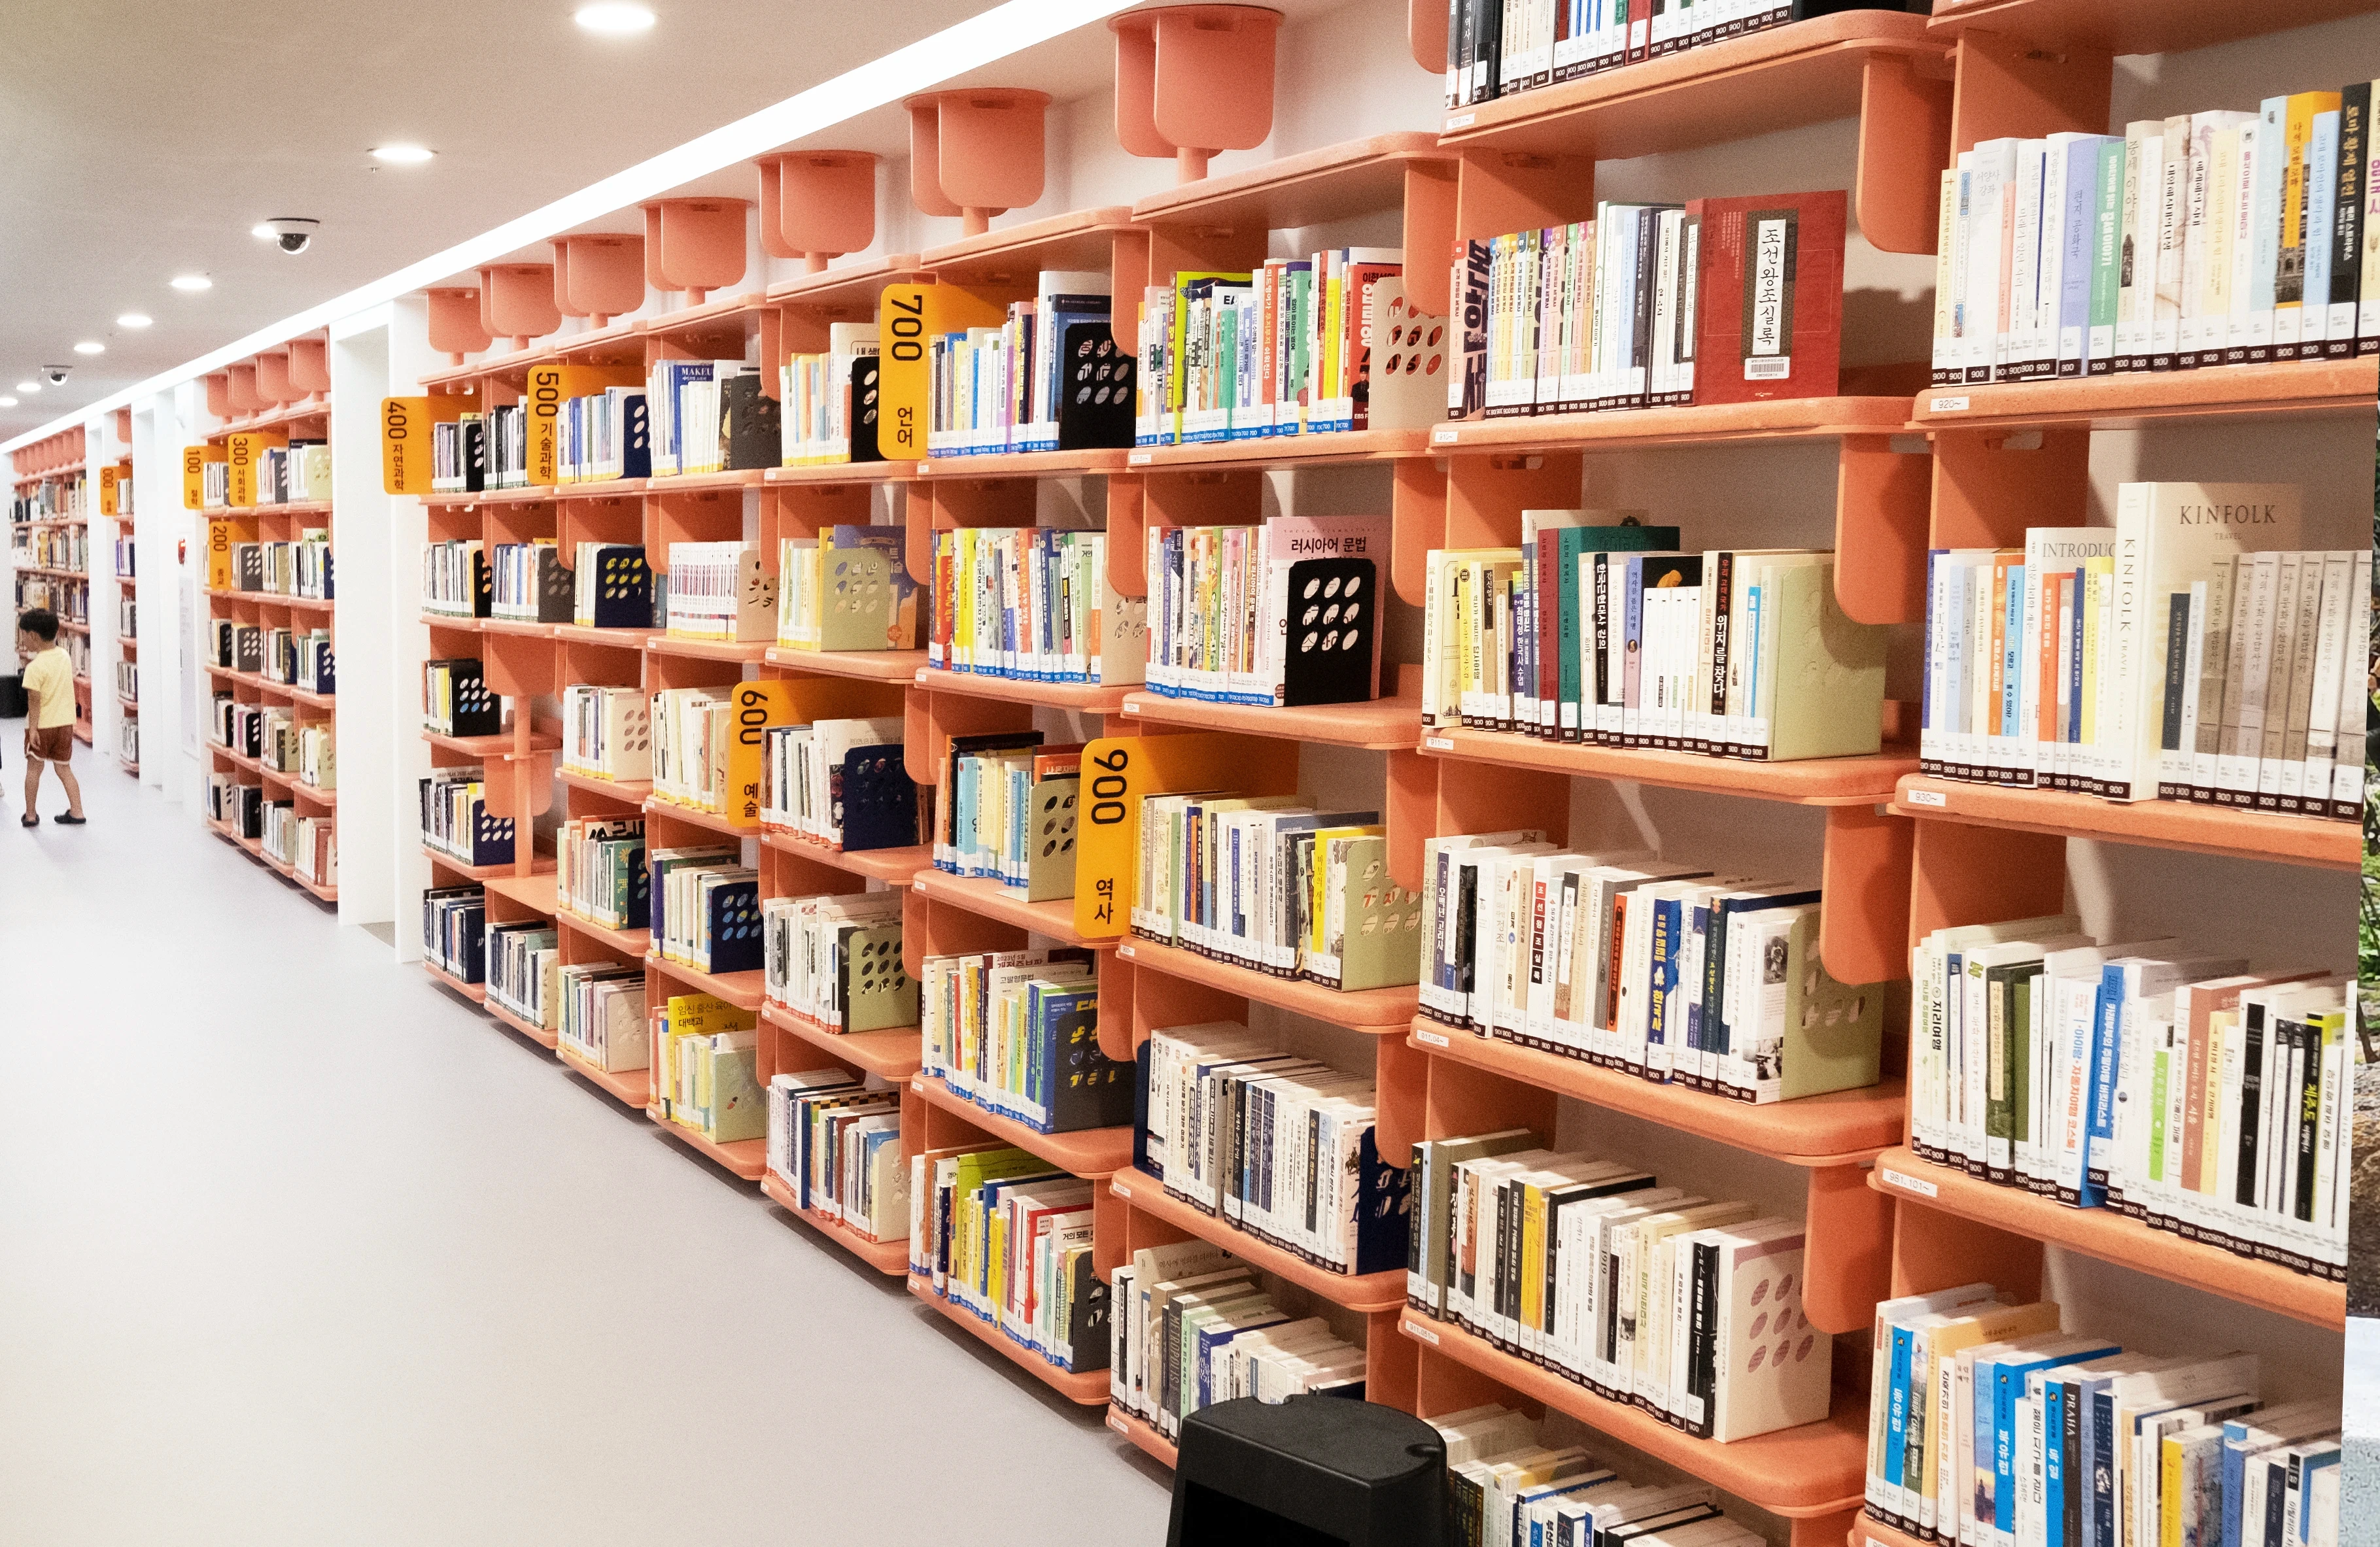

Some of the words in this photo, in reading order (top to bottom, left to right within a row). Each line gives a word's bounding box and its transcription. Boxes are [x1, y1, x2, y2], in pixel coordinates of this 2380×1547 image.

[1464, 18, 1471, 39] 역사
[2345, 105, 2360, 134] 로마
[2127, 141, 2138, 170] 중세
[2343, 137, 2358, 166] 황제
[1976, 171, 2000, 180] 서양사
[2341, 169, 2356, 196] 열전
[1980, 185, 1995, 196] 강좌
[2075, 190, 2082, 215] 편지
[2124, 177, 2137, 224] 이야기
[2164, 165, 2175, 227] 대항해시대의
[2017, 208, 2026, 239] 미래가
[2345, 206, 2355, 220] 배리
[2163, 230, 2172, 250] 탄생
[2016, 243, 2025, 263] 있던
[1759, 229, 1780, 344] 조선왕조실록
[2015, 268, 2024, 286] 자리
[891, 295, 922, 361] 700
[1290, 336, 1296, 350] 영어
[2277, 347, 2294, 356] 900
[2092, 362, 2106, 371] 900
[536, 373, 559, 416] 500
[1938, 400, 1961, 408] 920~
[388, 401, 407, 439] 400
[897, 407, 913, 447] 언어
[187, 451, 200, 473] 100
[233, 438, 248, 466] 300
[541, 424, 553, 480] 기술과학
[103, 469, 114, 488] 000
[392, 445, 404, 491] 자연과학
[2180, 505, 2276, 524] KINFOLK
[213, 526, 227, 551] 200
[1292, 537, 1338, 553] 러시아어
[1343, 537, 1366, 552] 문법
[1250, 549, 1257, 564] 파워
[1597, 564, 1606, 624] 한국근현대사
[2121, 539, 2135, 632] KINFOLK
[1249, 598, 1254, 612] 문법
[1597, 629, 1606, 650] 강의
[1715, 615, 1727, 663] 위치를
[2119, 639, 2128, 678] TRAVEL
[1517, 668, 1524, 687] 수업
[1714, 666, 1725, 698] 찾다
[740, 690, 768, 745] 600
[1971, 768, 1983, 777] 900
[1091, 749, 1128, 824] 900
[1916, 792, 1937, 802] 930~
[2109, 785, 2123, 794] 900
[2194, 790, 2209, 800] 900
[744, 783, 758, 817] 예술
[2281, 798, 2297, 809] 900
[1094, 878, 1113, 925] 역사
[1316, 891, 1322, 912] 세계
[1436, 923, 1445, 951] 고려사
[1532, 882, 1545, 983] 조선왕조실록
[1000, 974, 1034, 983] 고딸영문법
[678, 1005, 695, 1015] 임신
[697, 1003, 713, 1013] 출산
[716, 1002, 731, 1012] 육아
[678, 1017, 704, 1028] 대백과
[1932, 1000, 1942, 1051] 지리여행
[2073, 1028, 2084, 1059] 아이랑
[1649, 1071, 1659, 1080] 900
[2101, 1049, 2113, 1082] 주말여행
[1702, 1080, 1712, 1089] 900
[2069, 1065, 2082, 1117] 자동차여행
[2097, 1085, 2110, 1127] 버킷리스트
[2303, 1083, 2317, 1121] 제주도
[2067, 1118, 2077, 1149] 코스북
[1932, 1150, 1944, 1159] 900
[1889, 1173, 1929, 1191] 981.101~
[1991, 1171, 2004, 1180] 900
[2060, 1191, 2075, 1200] 900
[1063, 1232, 1075, 1240] 거의
[1077, 1231, 1089, 1239] 모든
[1169, 1314, 1181, 1383] METROPOLIS
[1911, 1393, 1921, 1416] EUROPE
[2067, 1393, 2076, 1436] PRAHA
[1689, 1423, 1699, 1433] 900
[1909, 1417, 1918, 1448] CAMPING
[1885, 1513, 1897, 1524] 900
